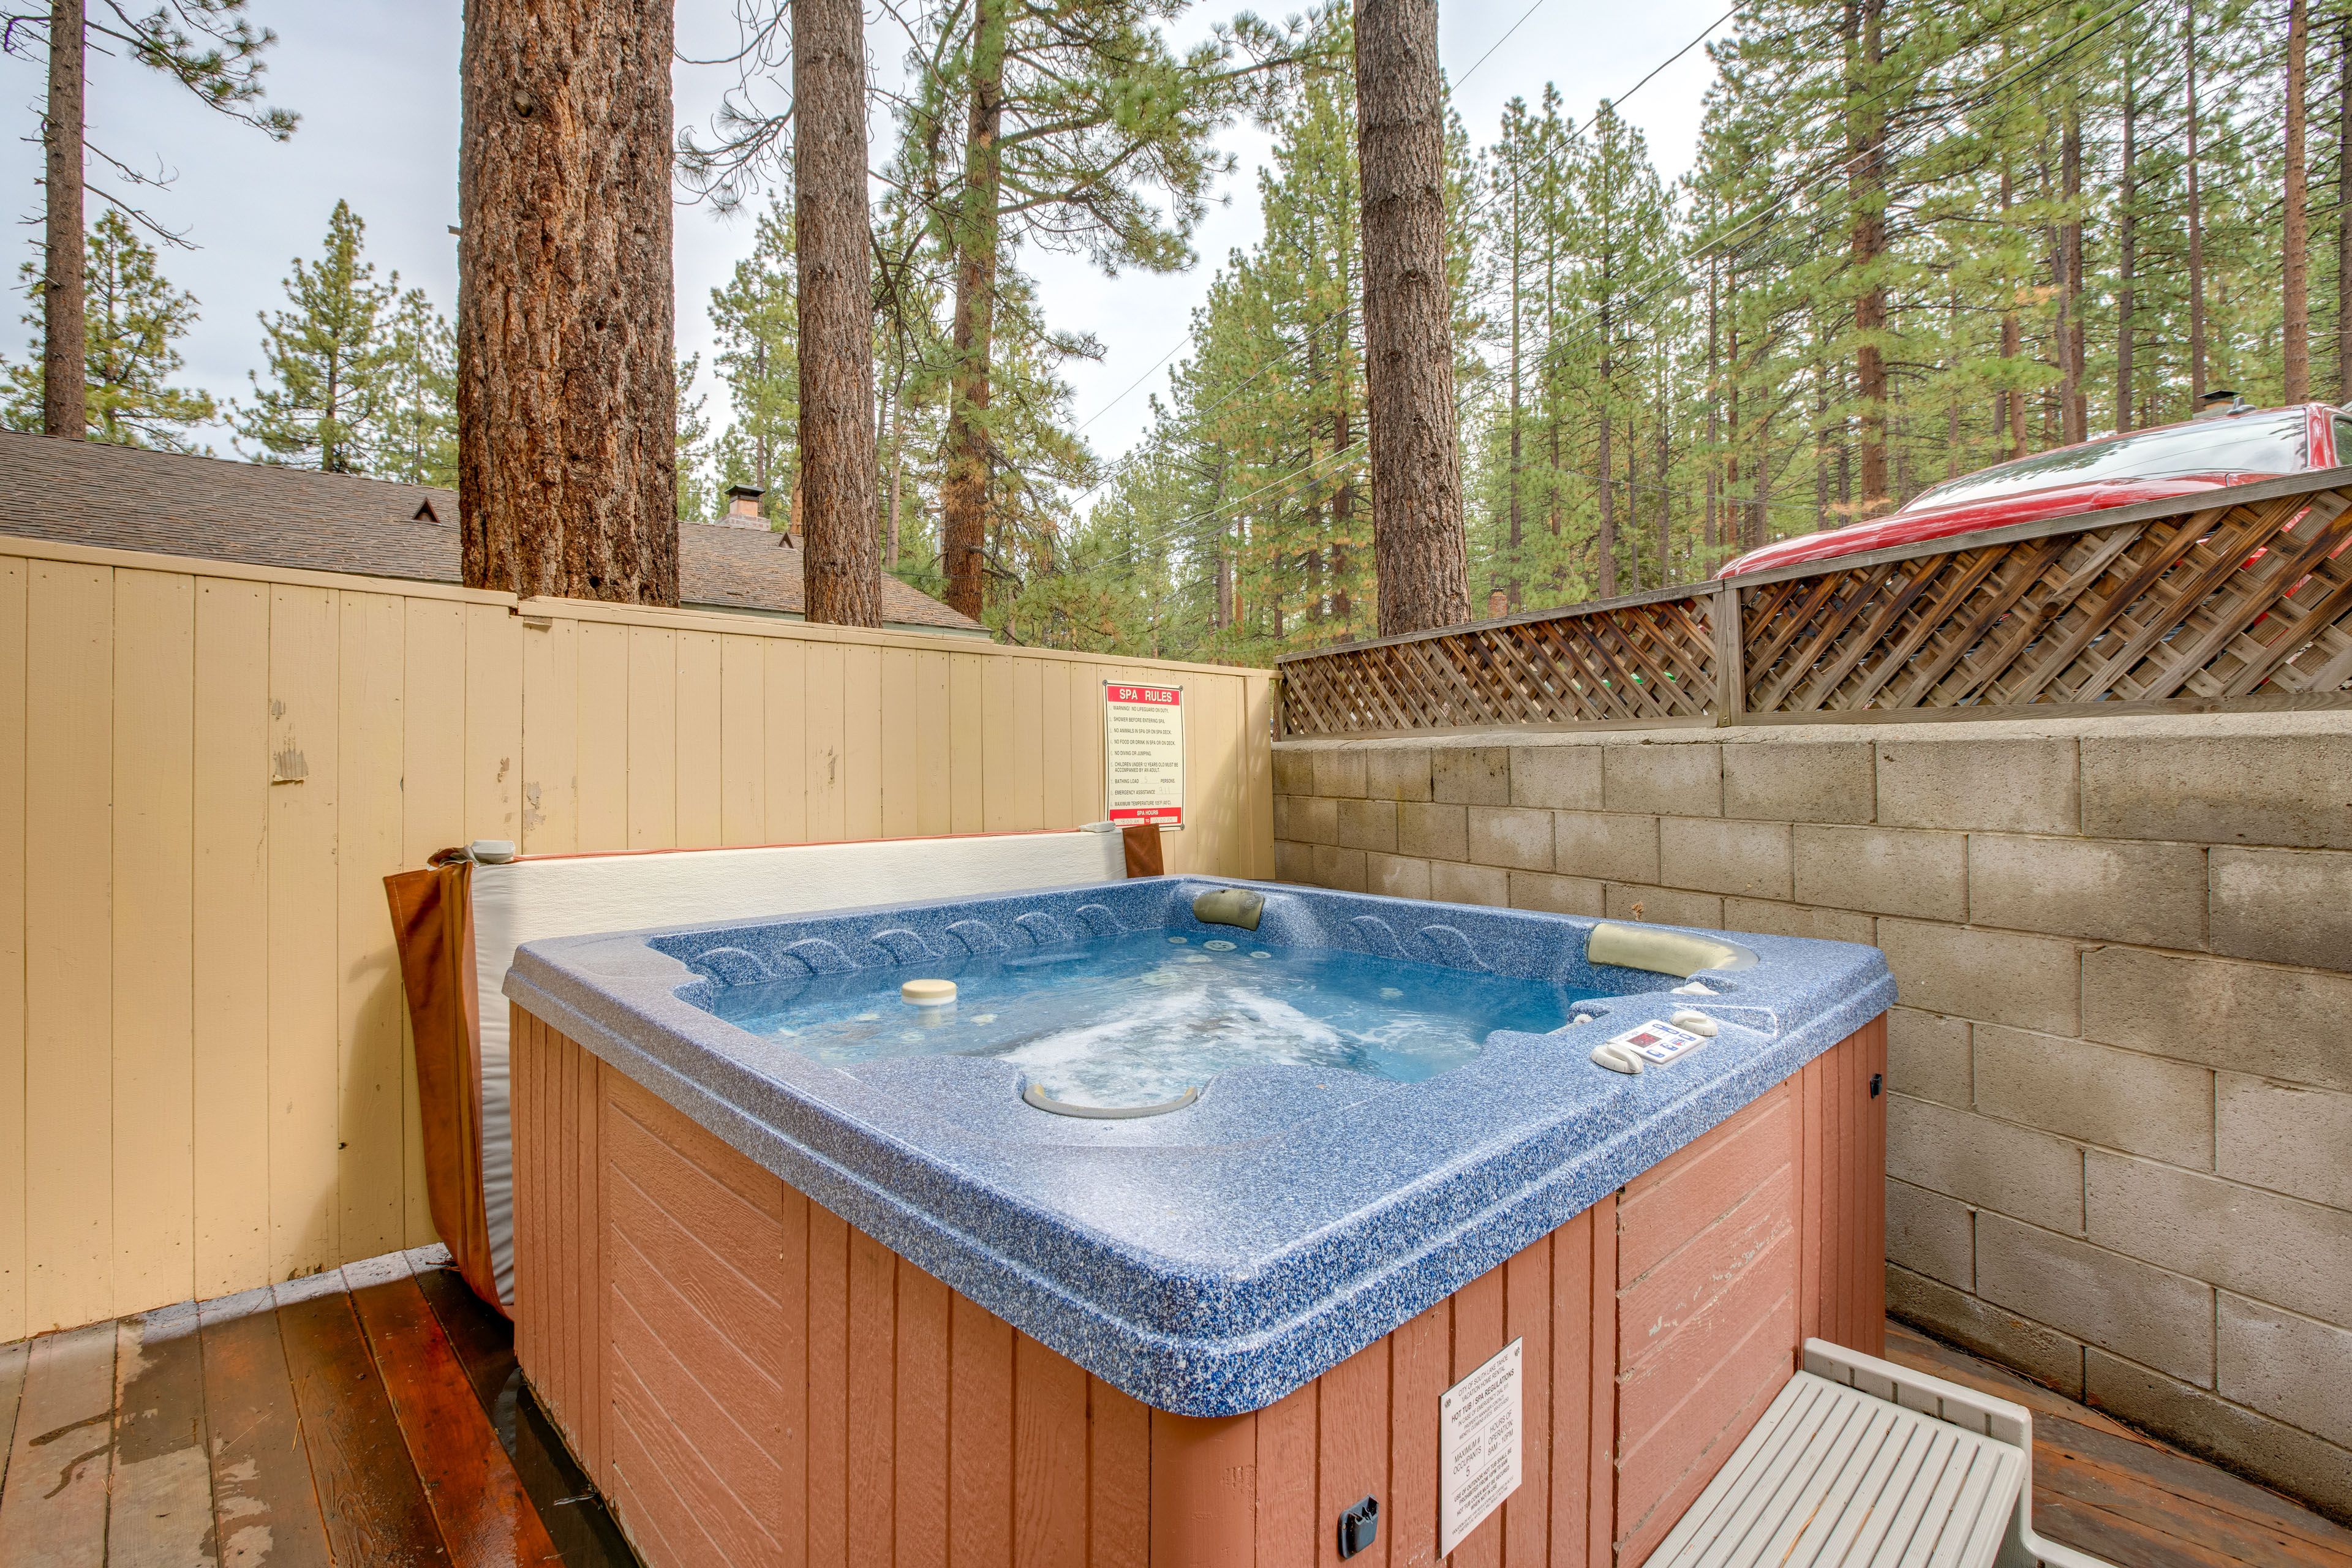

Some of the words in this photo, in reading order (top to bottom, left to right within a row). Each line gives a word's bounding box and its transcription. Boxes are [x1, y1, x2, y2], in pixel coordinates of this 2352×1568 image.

[1120, 689, 1138, 700] SPA
[1145, 690, 1172, 702] RULES
[1462, 1385, 1480, 1403] VACATION
[1481, 1376, 1491, 1389] HOME
[1492, 1366, 1505, 1380] RENTAL
[1468, 1381, 1473, 1390] OF
[1474, 1371, 1487, 1385] SOUTH
[1487, 1363, 1496, 1375] LAKE
[1497, 1354, 1508, 1368] TAHOE
[1452, 1410, 1461, 1423] HOT
[1485, 1369, 1513, 1397] REGULATIONS
[1477, 1393, 1496, 1412] EMERGENCY
[1464, 1415, 1479, 1430] PROPERTY
[1479, 1405, 1491, 1419] MANAGER
[1490, 1415, 1505, 1434] HOURS
[1506, 1409, 1512, 1420] OF
[1455, 1439, 1477, 1464] MAXIMUM
[1488, 1442, 1498, 1457] 8AM
[1502, 1428, 1513, 1444] 10PM
[1453, 1446, 1481, 1476] OCCUPANTS
[1462, 1487, 1466, 1496] OF
[1467, 1473, 1483, 1491] OUTDOOR
[1498, 1452, 1507, 1464] SHALL
[1466, 1466, 1469, 1478] 5
[1460, 1484, 1479, 1506] PROHIBITED
[1479, 1476, 1488, 1488] FROM
[1471, 1490, 1482, 1504] COVER
[1496, 1465, 1509, 1482] SECURED
[1471, 1499, 1480, 1511] WHEN
